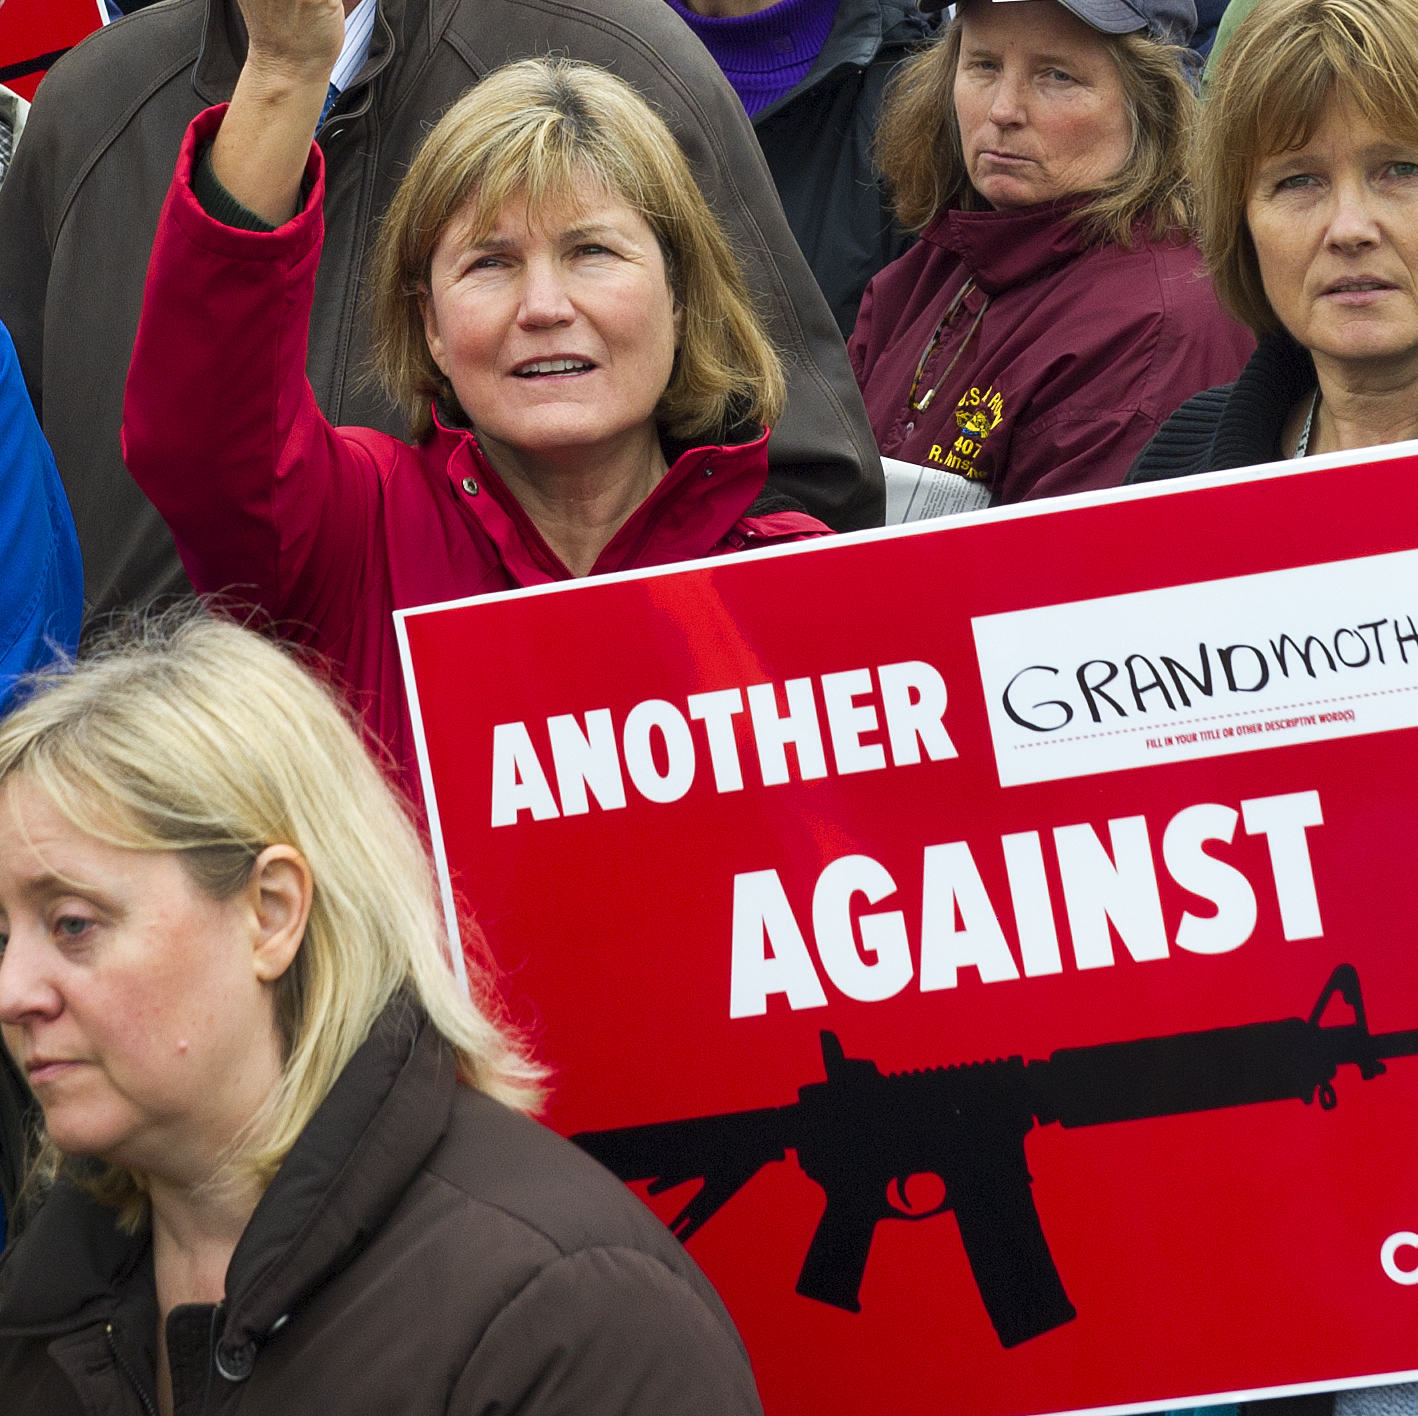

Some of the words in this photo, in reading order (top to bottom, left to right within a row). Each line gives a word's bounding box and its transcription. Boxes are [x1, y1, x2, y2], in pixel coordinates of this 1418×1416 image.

[492, 661, 958, 827] ANOTHER
[1145, 737, 1163, 749] FILL
[1164, 736, 1173, 746] IN
[1175, 733, 1198, 744] YOUR
[1199, 729, 1221, 741] TITLE
[1222, 727, 1235, 738] OR
[1236, 722, 1263, 735] OTHER
[1264, 715, 1317, 731] DESCRIPTIVE
[1318, 709, 1355, 724] WORD(S)
[730, 790, 1324, 1019] AGAINST
